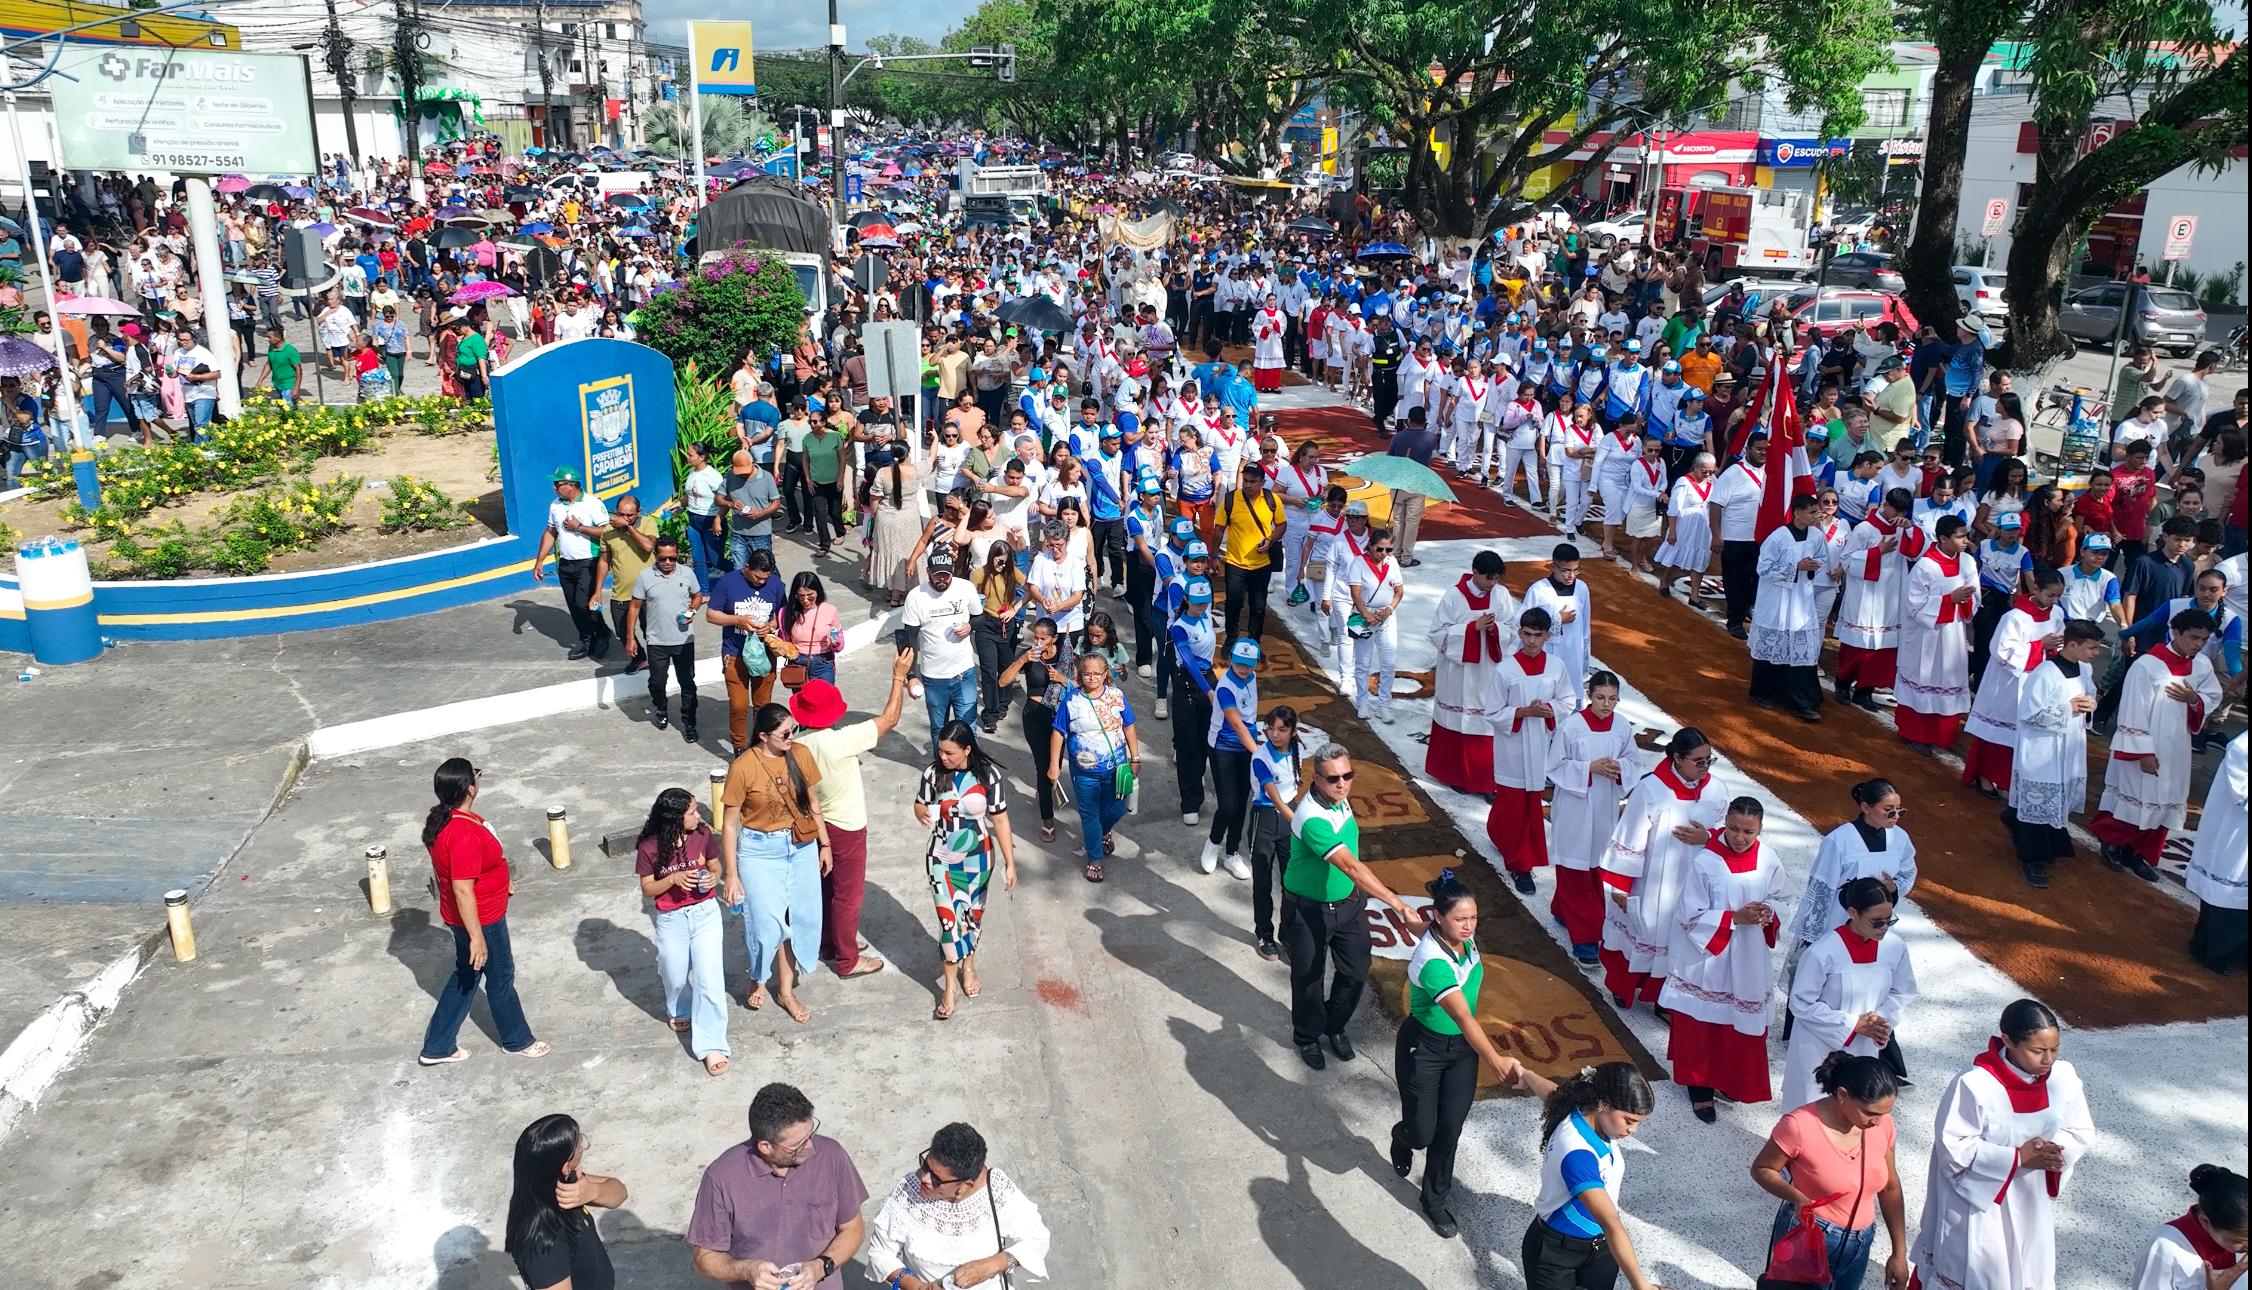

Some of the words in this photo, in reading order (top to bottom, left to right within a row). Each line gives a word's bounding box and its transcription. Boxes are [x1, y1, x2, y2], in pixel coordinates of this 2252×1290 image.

[135, 58, 256, 82] FarMais
[1794, 147, 1829, 158] ESCUDO
[153, 154, 166, 167] 91
[169, 154, 245, 168] 98527-5541
[2177, 223, 2188, 236] E
[592, 446, 624, 464] PREFEITURA
[624, 442, 633, 454] DE
[593, 452, 634, 476] CAPANEMA
[931, 553, 953, 566] VOZÃO
